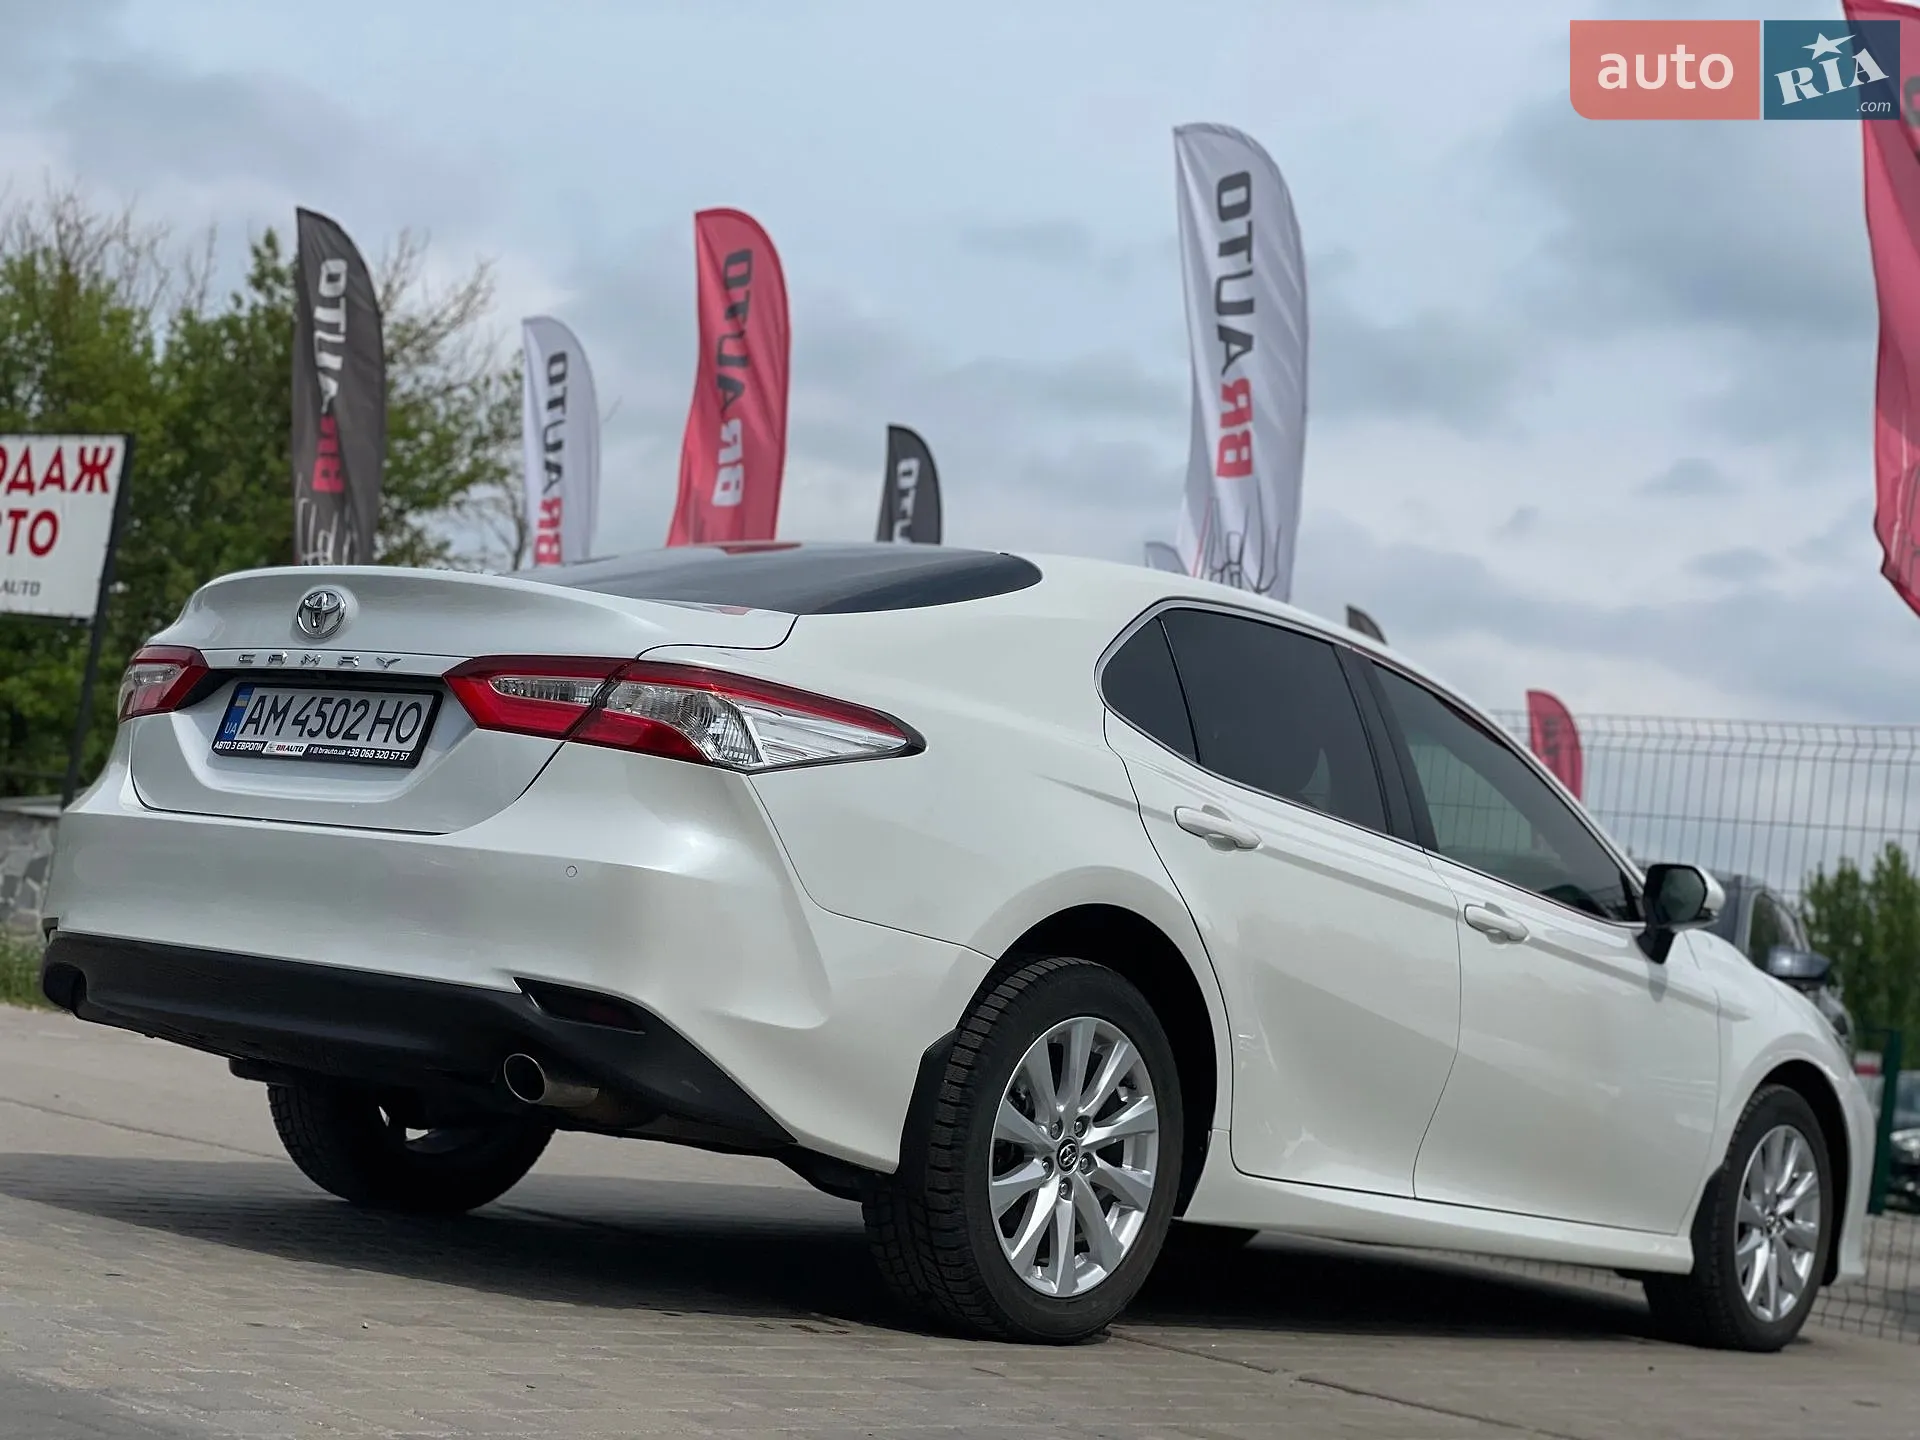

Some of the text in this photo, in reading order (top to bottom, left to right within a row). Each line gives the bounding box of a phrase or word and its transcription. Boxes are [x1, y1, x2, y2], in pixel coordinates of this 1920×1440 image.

[0, 507, 60, 557] ТО
[238, 649, 401, 669] CAMRY
[224, 721, 237, 735] UA
[239, 695, 423, 744] AM 4502 HO
[276, 744, 304, 753] BRAUTO
[346, 748, 360, 757] +38
[360, 749, 374, 759] 068
[374, 751, 390, 760] 320
[389, 752, 400, 761] 57
[400, 752, 411, 761] 57
